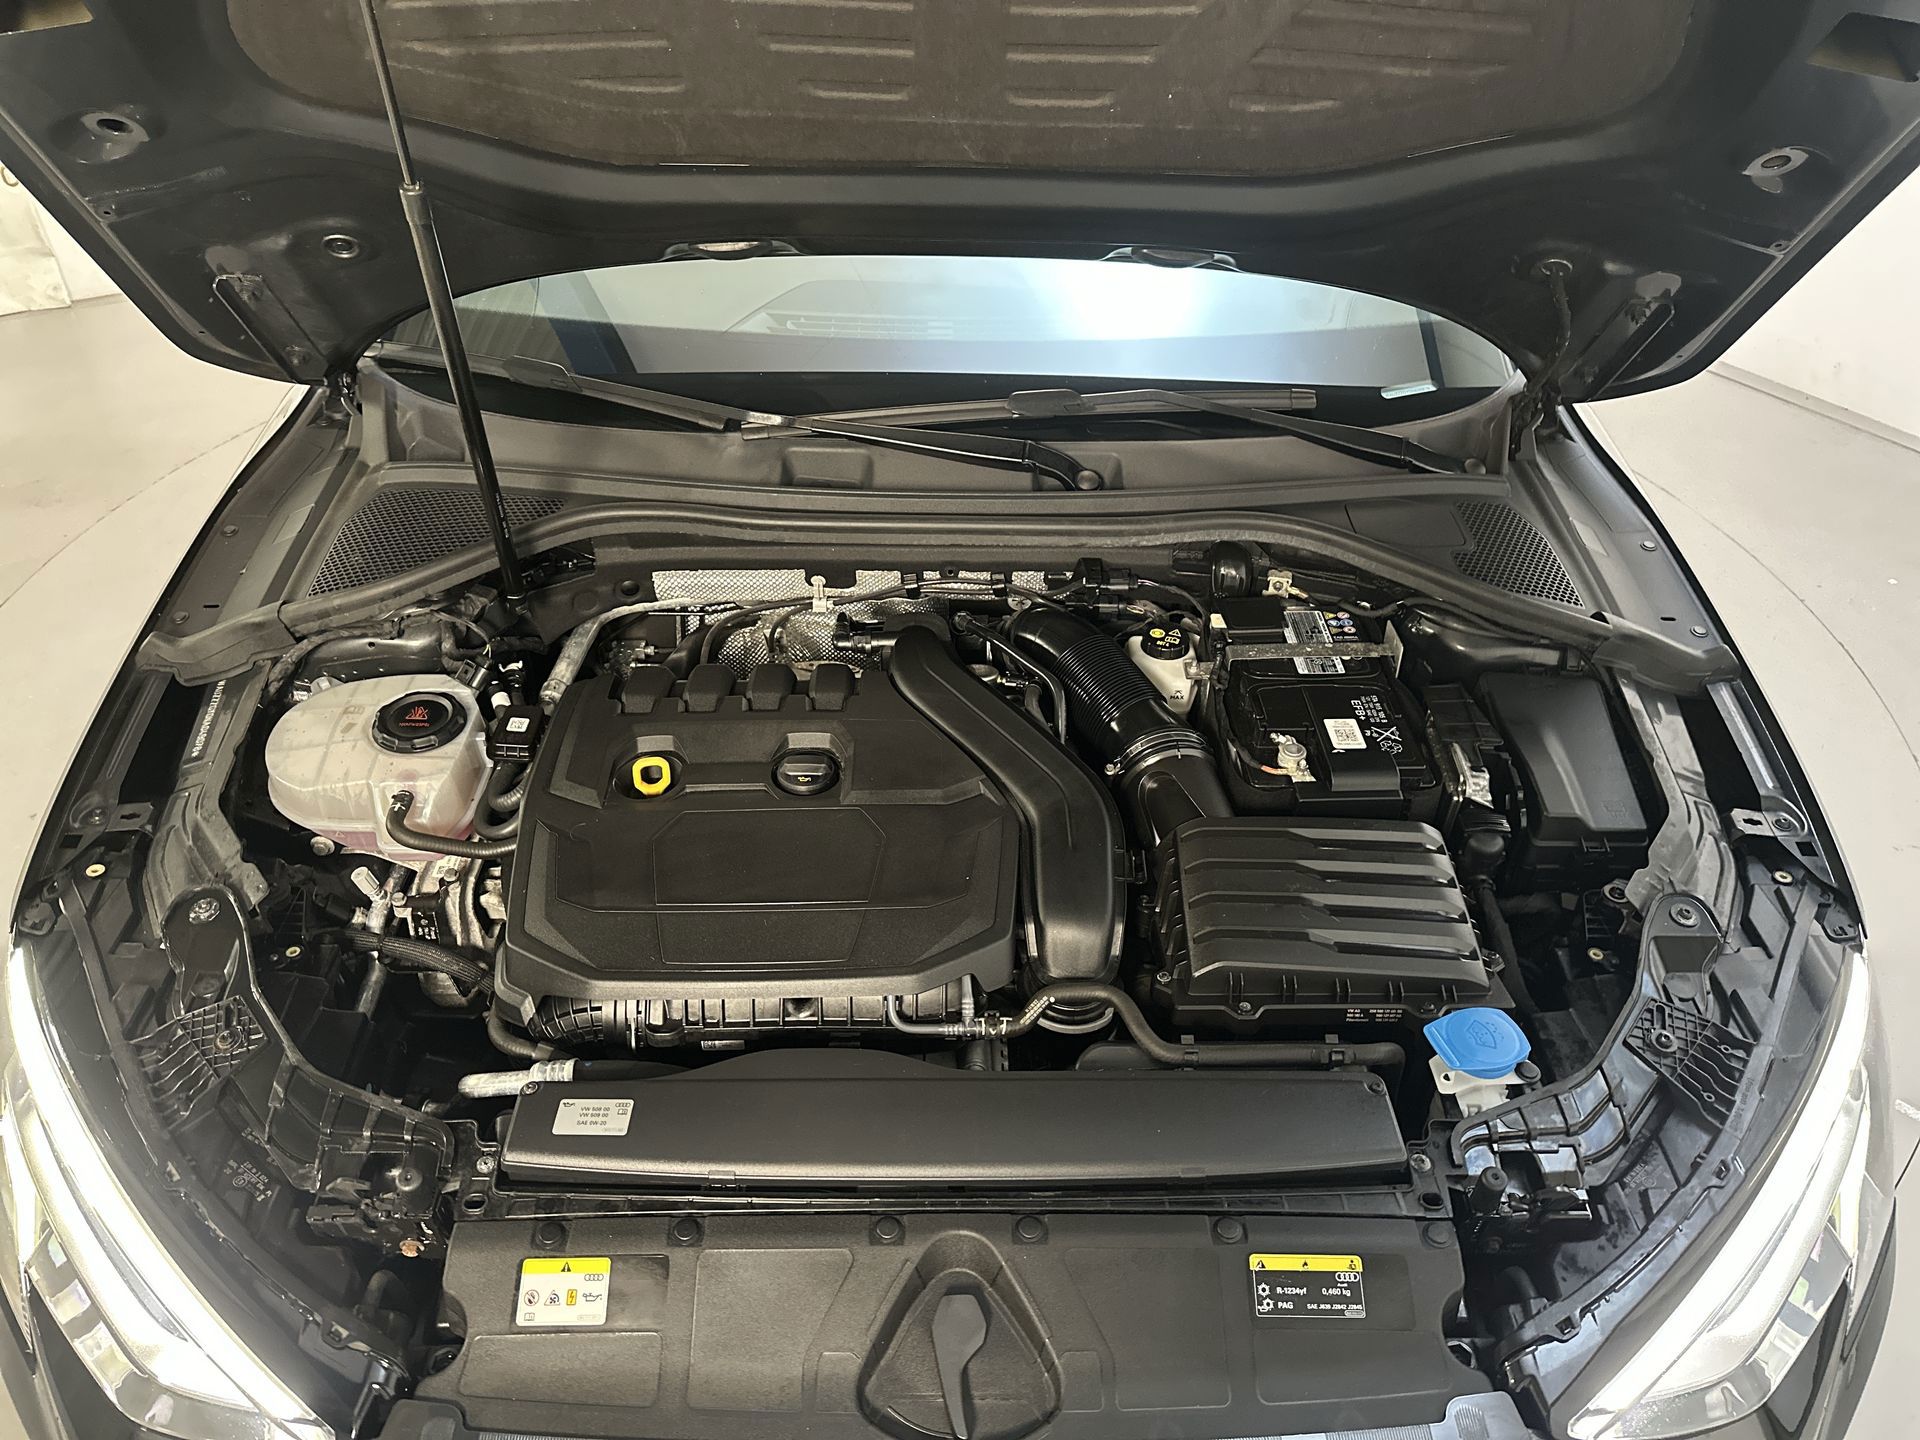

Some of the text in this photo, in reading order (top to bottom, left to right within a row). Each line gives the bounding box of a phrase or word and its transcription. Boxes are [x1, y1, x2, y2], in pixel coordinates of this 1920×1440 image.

[1350, 700, 1366, 720] EFB+
[1276, 1286, 1351, 1296] R-1234yf 0,460 kg
